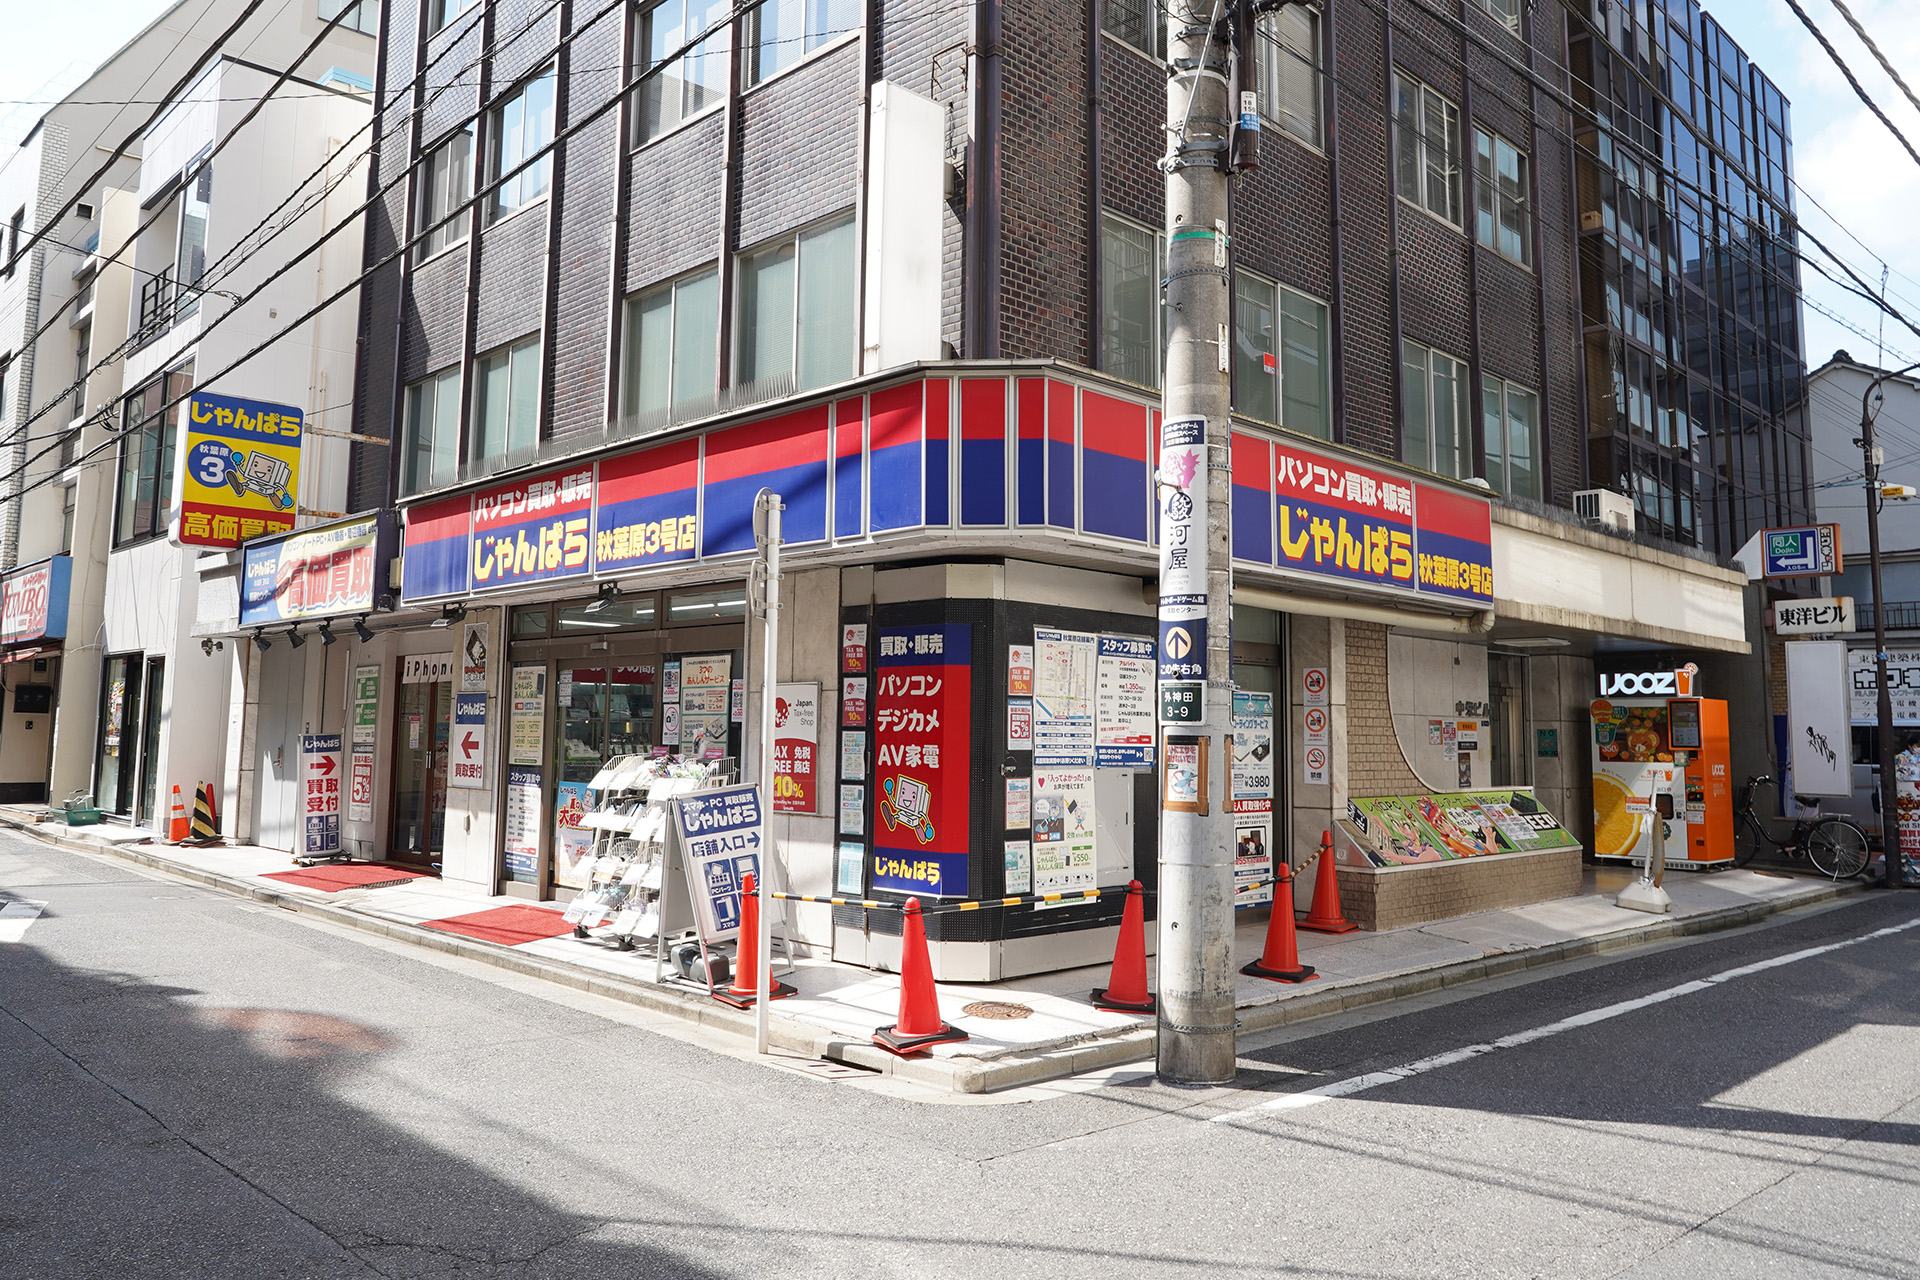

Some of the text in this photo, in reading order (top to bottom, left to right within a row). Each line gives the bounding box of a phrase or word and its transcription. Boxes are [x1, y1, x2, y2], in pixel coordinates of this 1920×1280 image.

[191, 401, 300, 438] じゃんぱら
[200, 444, 229, 457] 秋葉原
[200, 457, 225, 484] 3
[1278, 455, 1412, 517] パソコン買取・販売
[475, 471, 592, 523] パソコン買取・販売
[596, 514, 697, 563] 秋葉原3号店
[1280, 504, 1413, 581] じゃんぱら
[1772, 536, 1797, 548] 同人
[474, 518, 588, 583] じゃんぱら
[288, 547, 374, 612] 高価買取
[1419, 553, 1493, 596] 秋葉原3号店
[1779, 605, 1847, 626] 東洋ビル
[880, 634, 943, 656] 買取・販売
[1103, 640, 1152, 655] スタッフ募集中
[878, 675, 942, 697] パソコン
[1164, 692, 1193, 702] 外神田
[457, 703, 485, 715] じゃんぱら
[793, 709, 814, 717] Tax-free
[1166, 706, 1189, 717] 3-9
[800, 718, 814, 727] Shop
[877, 708, 940, 732] デジカメ
[305, 739, 339, 749] じゃんぱら
[774, 746, 811, 759] AX 免税
[877, 744, 940, 768] AV家電
[455, 764, 482, 779] 買取受付
[774, 760, 811, 774] REE 商店
[307, 778, 338, 795] 買取
[307, 795, 338, 813] 受付
[683, 793, 754, 811] スマホ・PC 買取販売
[684, 804, 757, 832] じゃんぱら
[1523, 814, 1557, 831] EEP
[691, 835, 746, 858] 店舗入口
[875, 856, 940, 886] じゃんぱら
